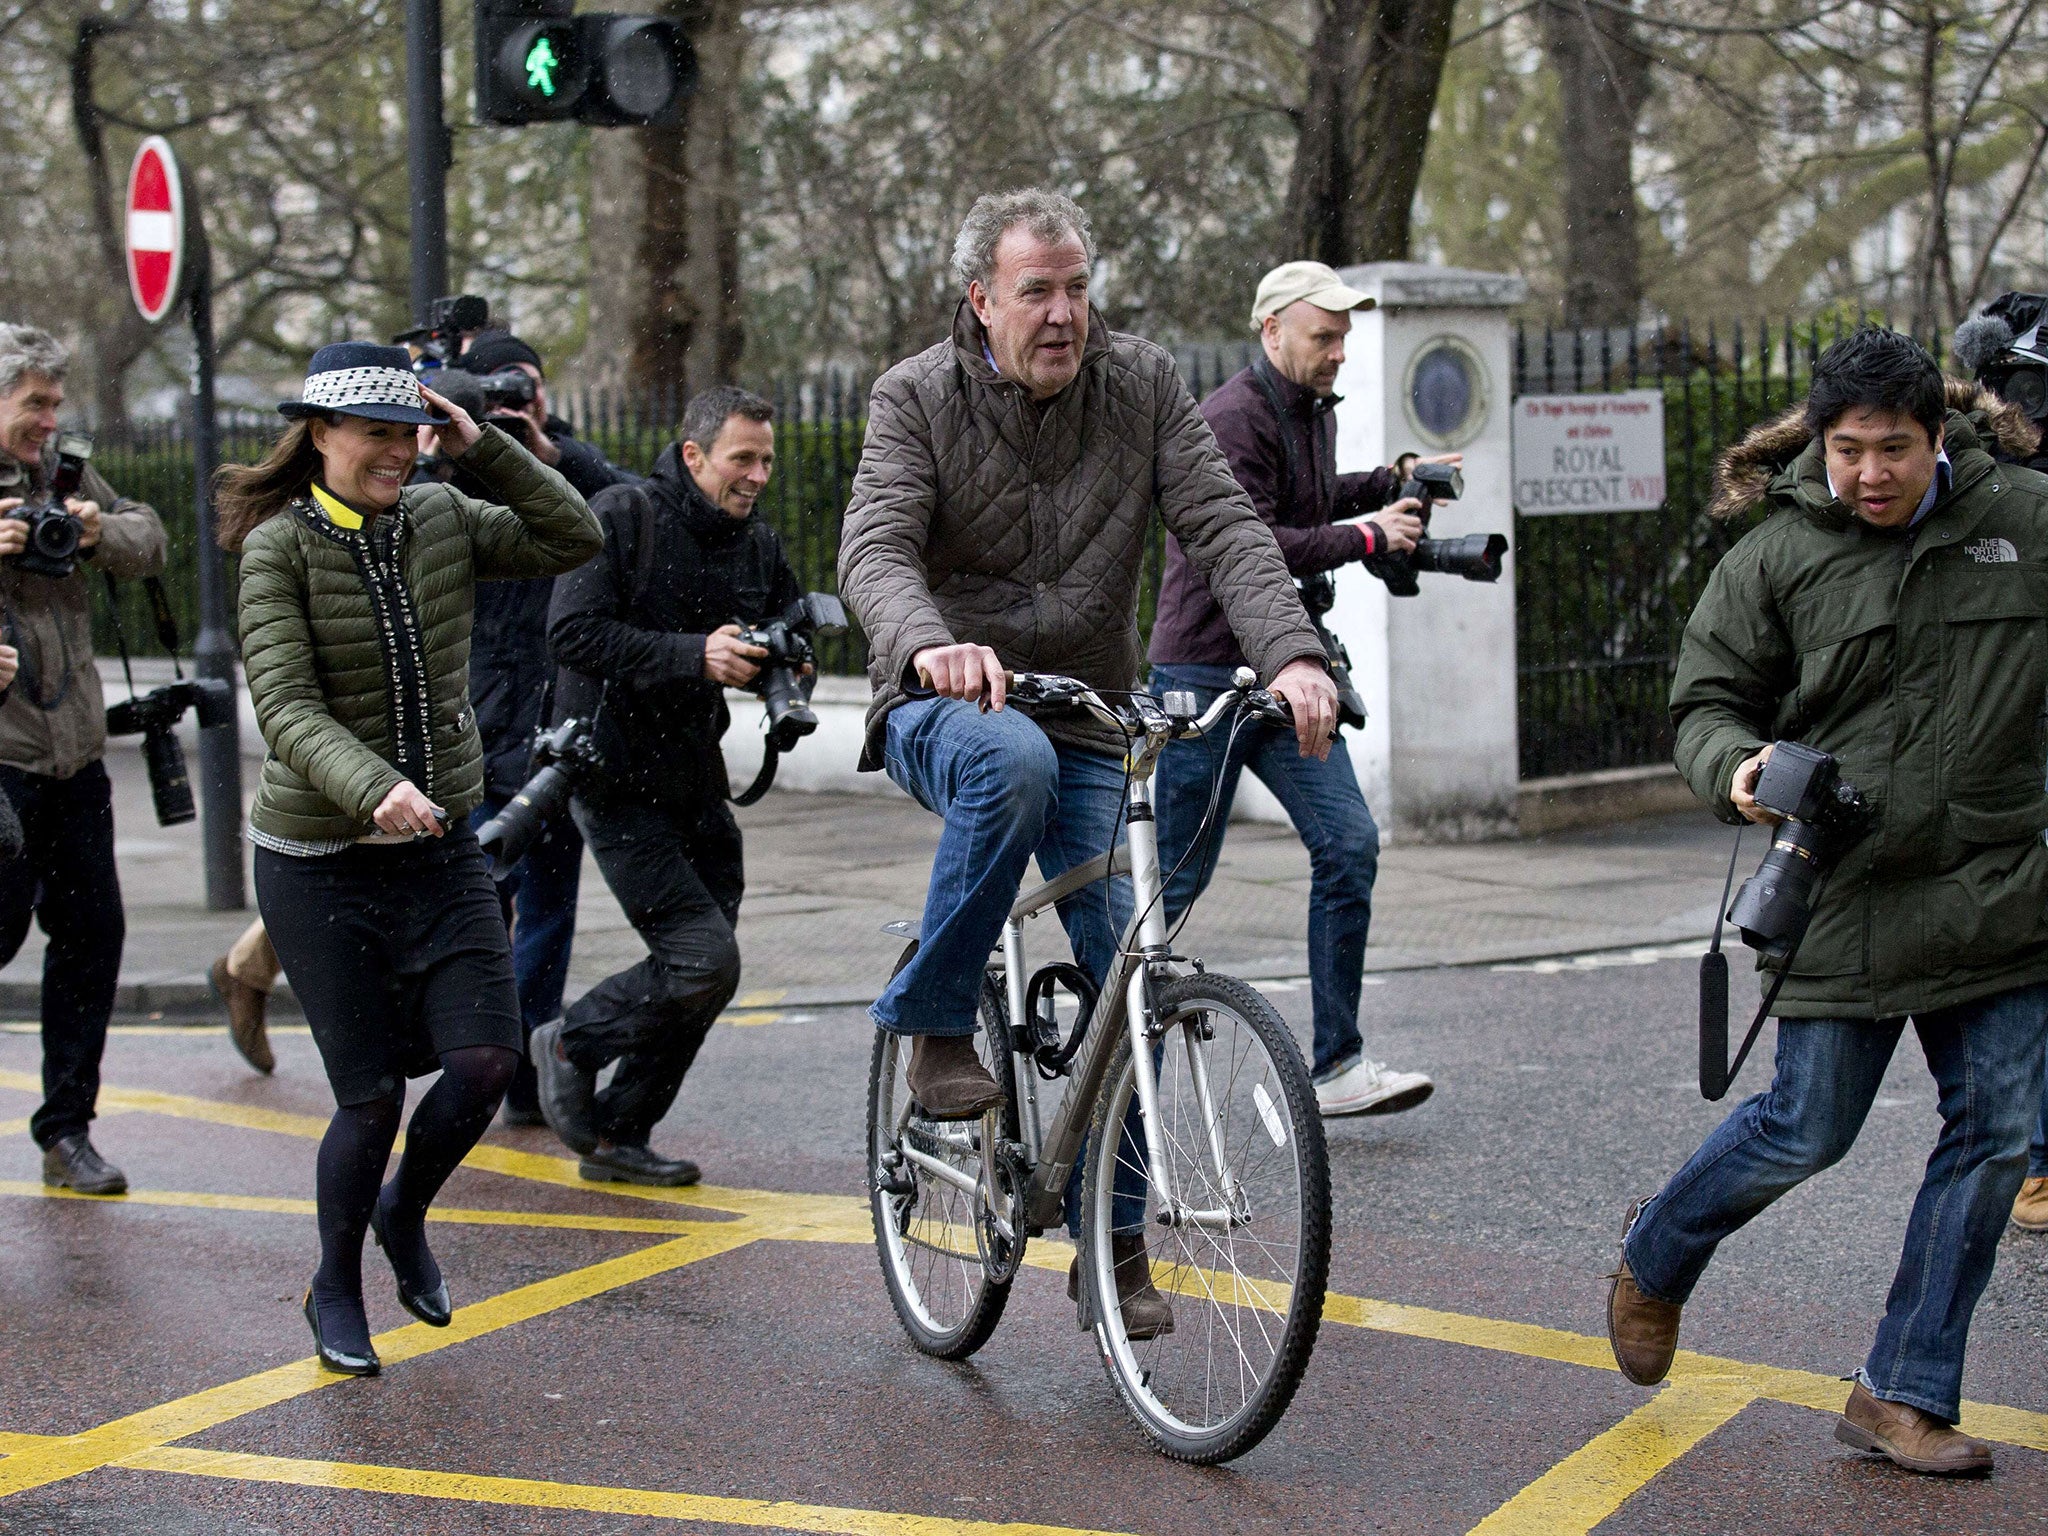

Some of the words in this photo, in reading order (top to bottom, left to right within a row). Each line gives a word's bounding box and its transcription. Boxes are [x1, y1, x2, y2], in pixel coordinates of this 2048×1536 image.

[1552, 446, 1623, 473] ROYAL
[1518, 477, 1622, 507] CRESCENT
[1978, 538, 1999, 547] THE
[1964, 546, 1999, 555] NORTH
[1974, 555, 2001, 563] FACE
